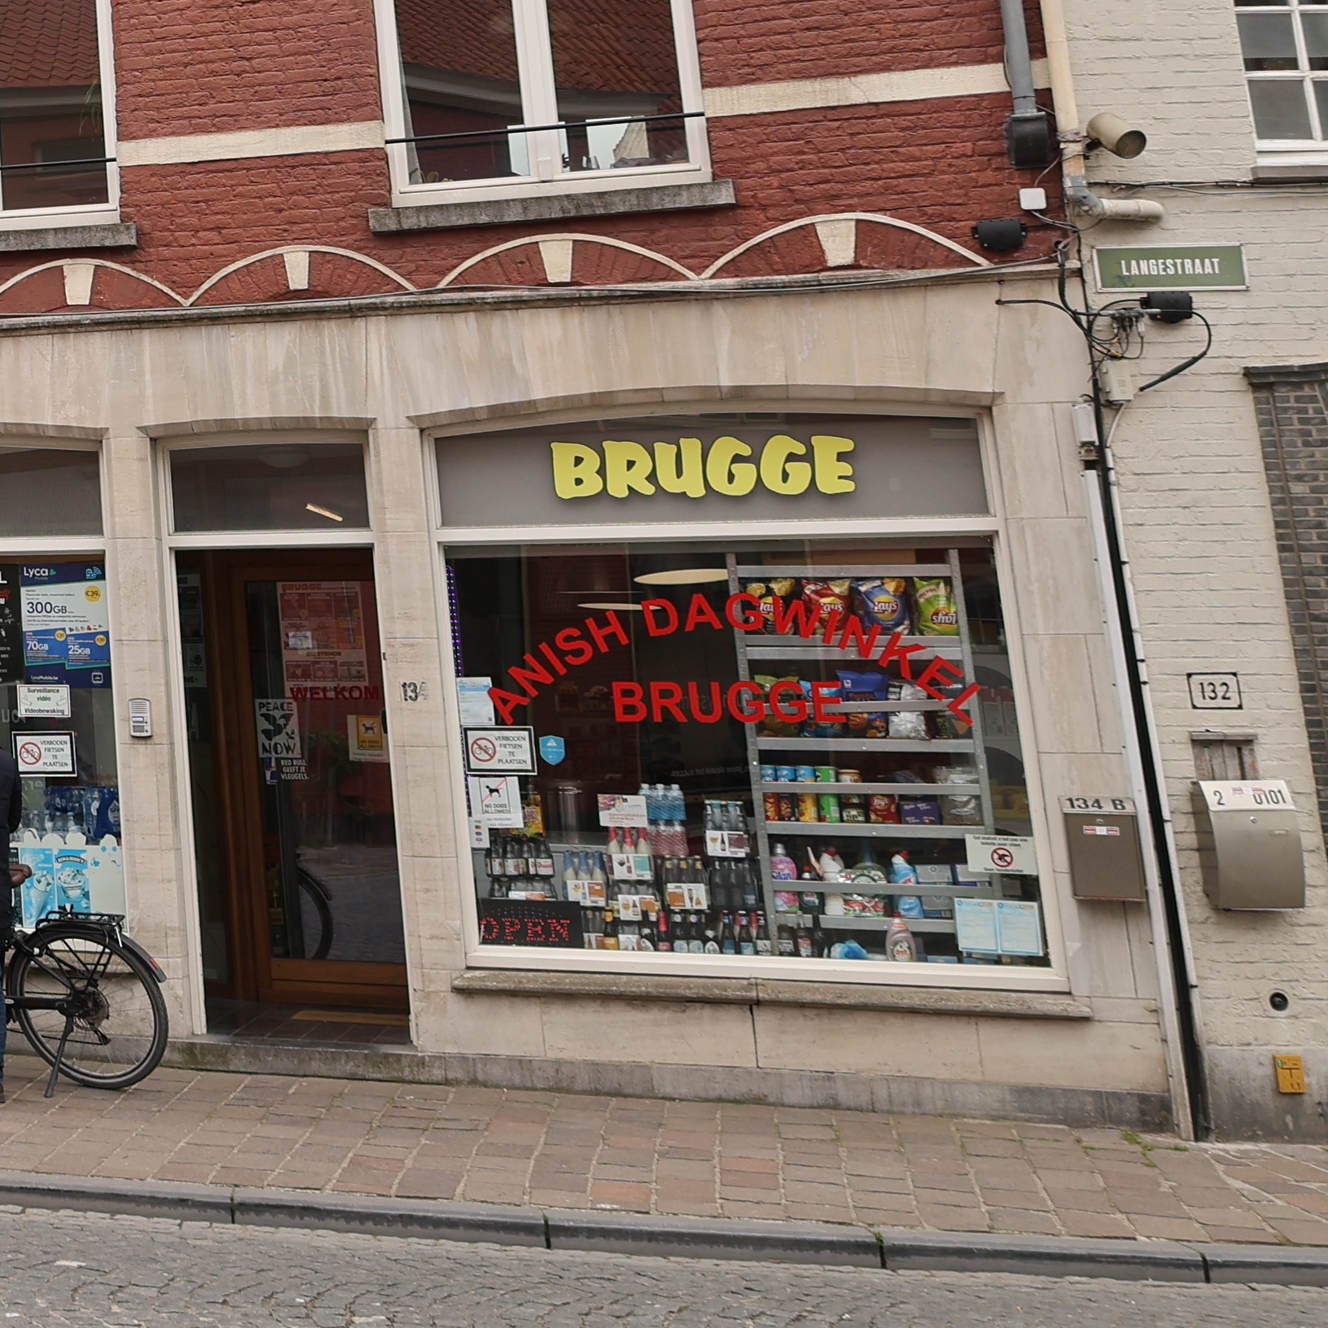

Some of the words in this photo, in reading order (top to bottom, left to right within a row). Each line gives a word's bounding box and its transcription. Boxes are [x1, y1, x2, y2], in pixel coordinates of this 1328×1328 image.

[1120, 258, 1220, 276] LANGESTRAAT
[550, 434, 856, 500] BRUGGE
[24, 566, 49, 577] Lyca
[68, 645, 91, 655] 25GB
[487, 609, 630, 726] ANISH
[640, 592, 982, 727] DAGWINKEL
[290, 685, 380, 702] WELKOM
[1198, 681, 1232, 701] 132
[258, 702, 294, 712] PEACE
[611, 679, 848, 724] BRUGGE
[261, 742, 297, 756] NOW
[1066, 797, 1104, 811] 134
[1111, 798, 1127, 811] B
[479, 916, 571, 943] OPEN
